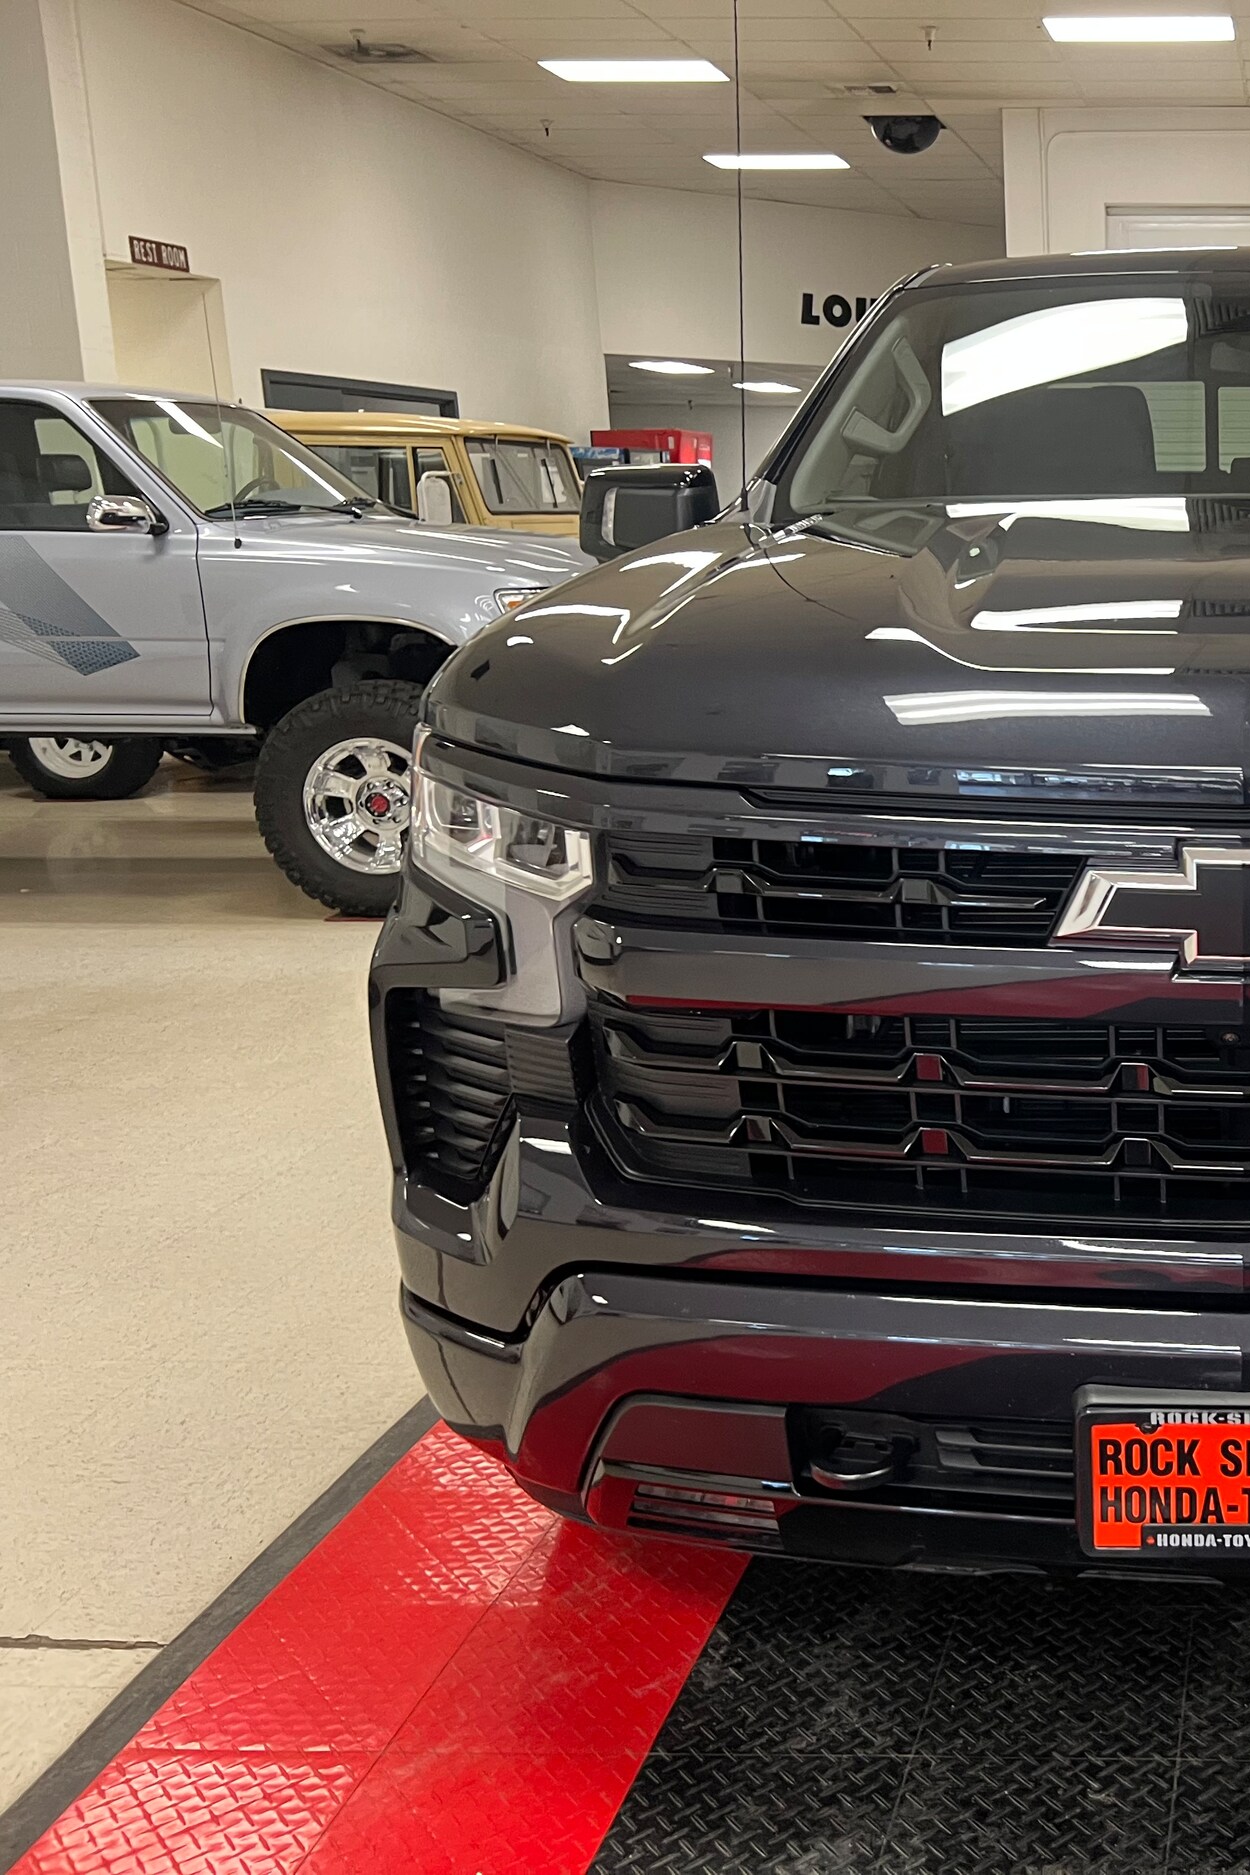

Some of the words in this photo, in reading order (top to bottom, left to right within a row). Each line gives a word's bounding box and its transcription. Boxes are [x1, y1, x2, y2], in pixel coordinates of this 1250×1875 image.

[133, 239, 158, 264] REST
[161, 245, 187, 269] ROOM
[1099, 1438, 1201, 1477] ROCK
